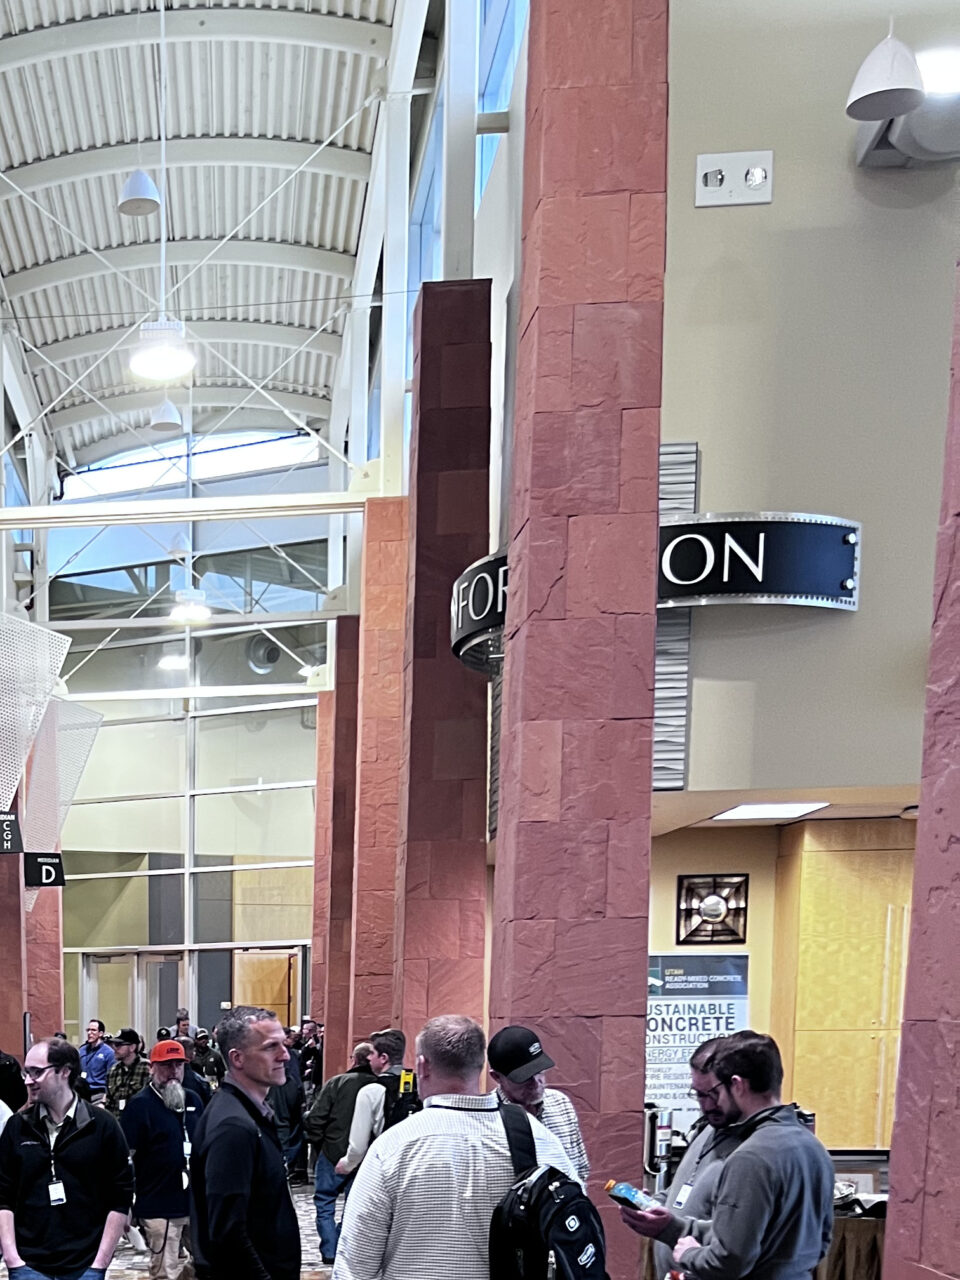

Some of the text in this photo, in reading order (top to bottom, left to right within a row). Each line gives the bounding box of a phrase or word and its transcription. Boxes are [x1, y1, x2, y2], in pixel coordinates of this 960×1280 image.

[661, 532, 766, 585] ON
[3, 821, 10, 830] C
[3, 831, 11, 840] G
[3, 841, 10, 849] H
[42, 865, 56, 884] D
[647, 1003, 735, 1016] USTAINABLE
[647, 1016, 735, 1032] ONCRETE
